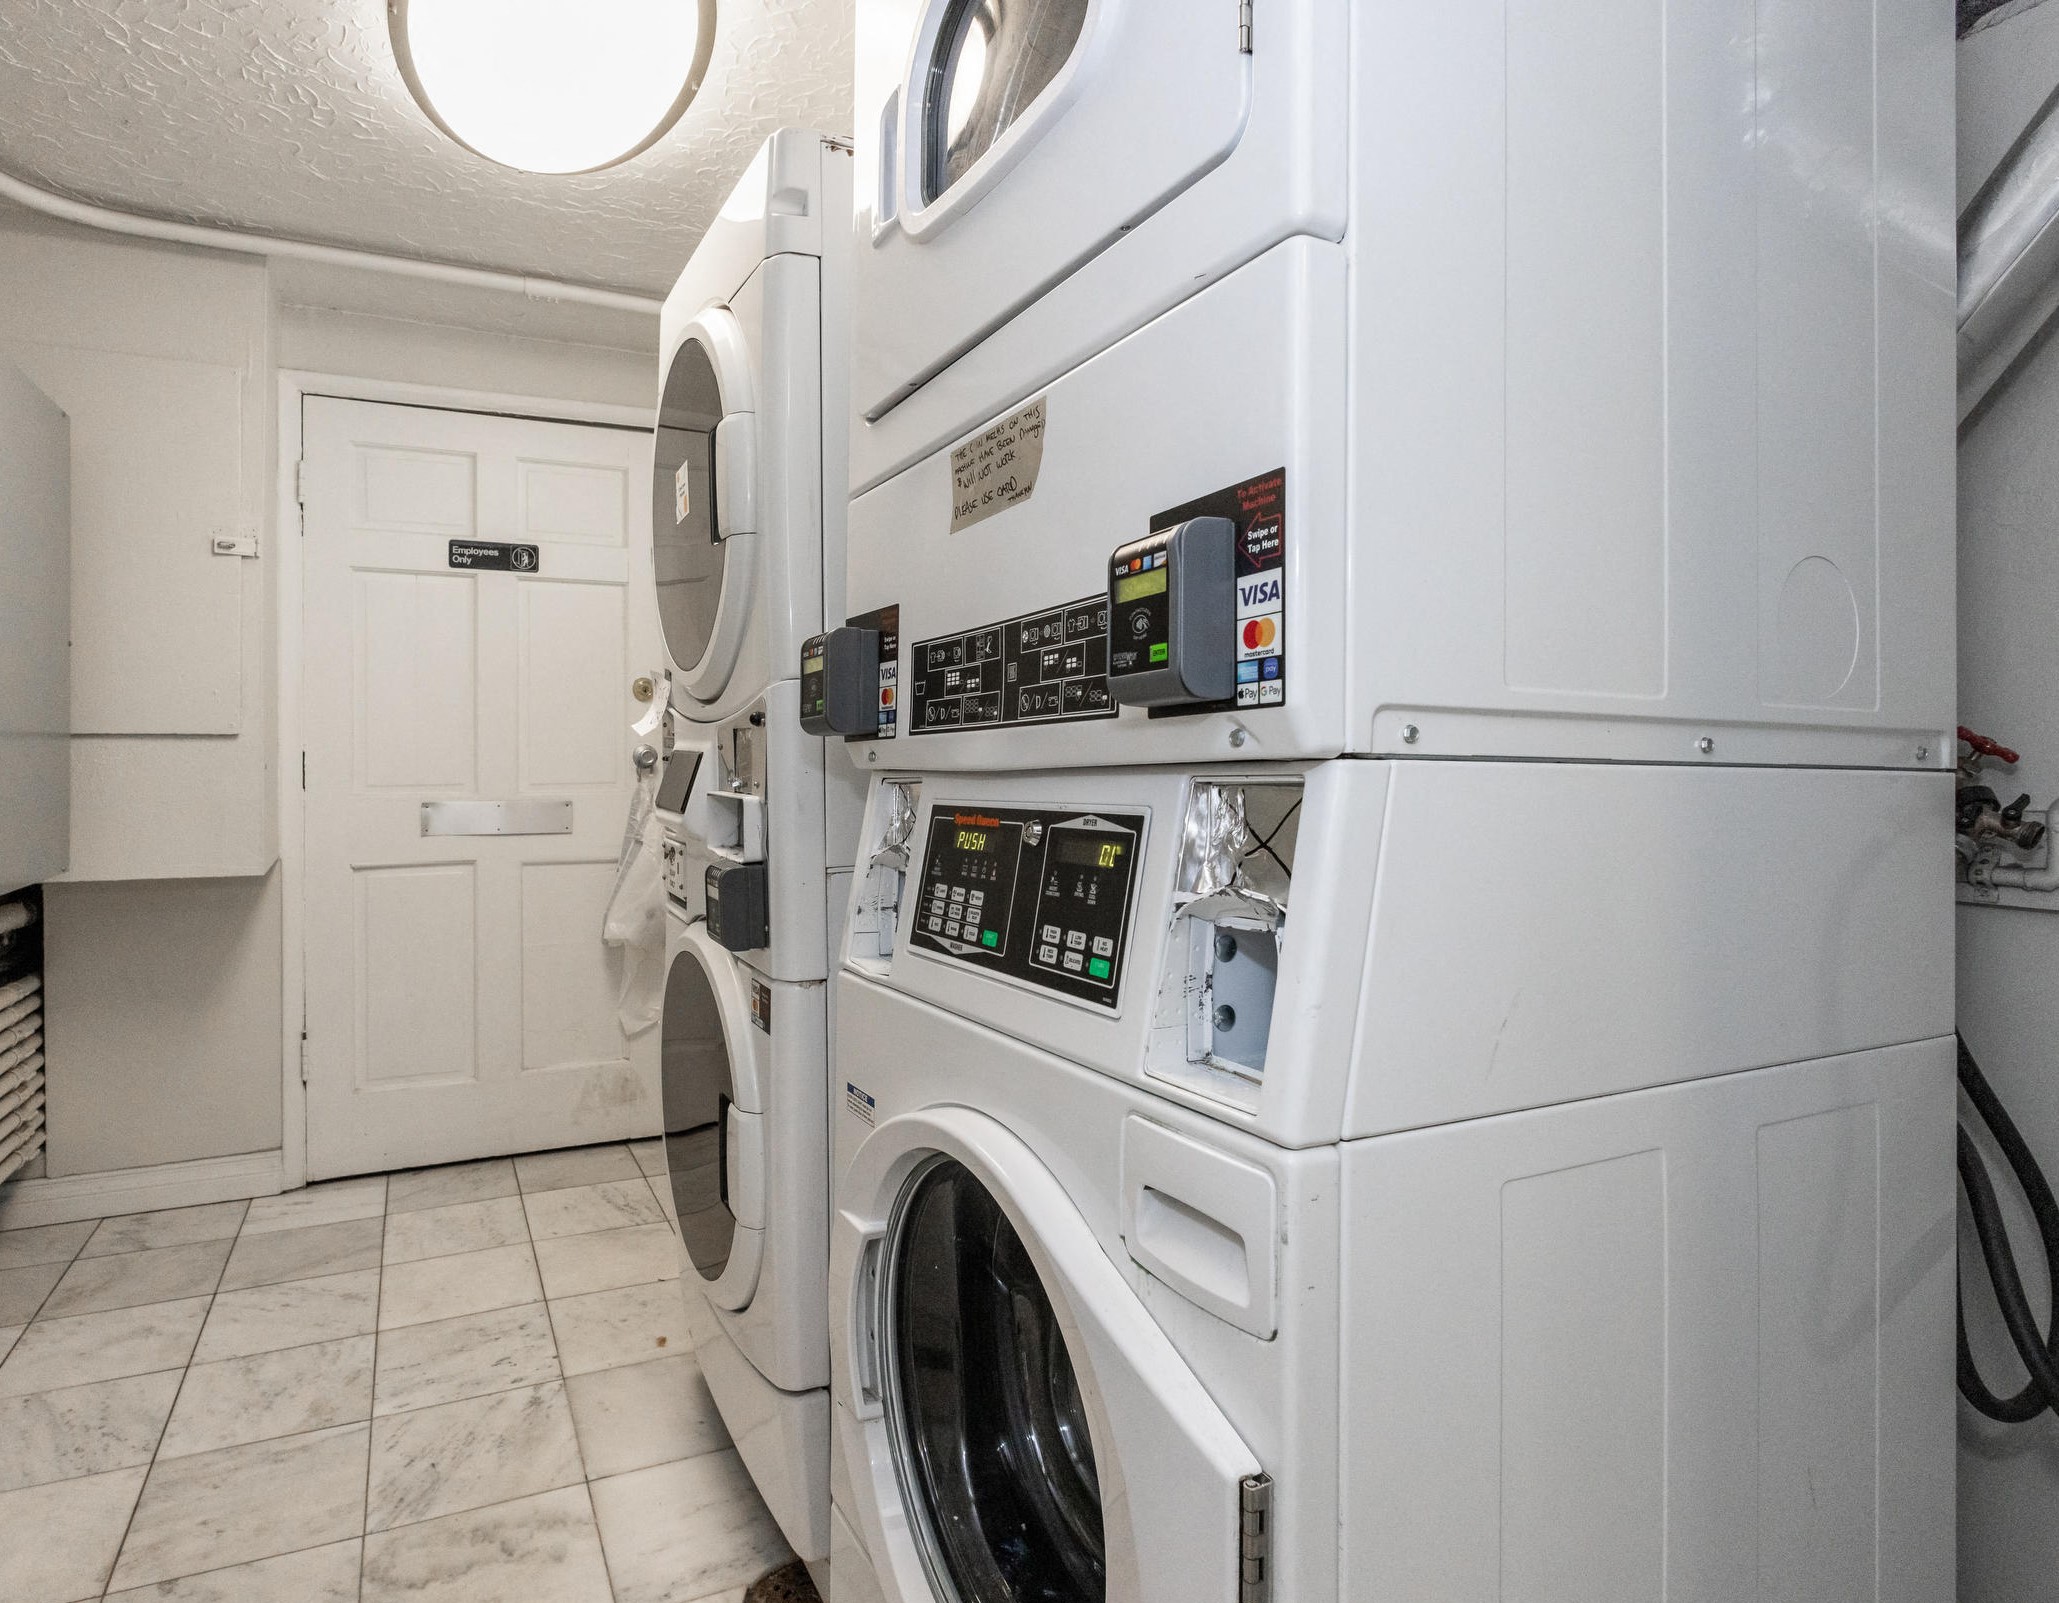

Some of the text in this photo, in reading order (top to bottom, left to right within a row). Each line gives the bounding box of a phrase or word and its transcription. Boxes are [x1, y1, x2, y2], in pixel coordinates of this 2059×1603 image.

[1009, 418, 1019, 430] ON
[1023, 405, 1041, 421] THIS
[997, 435, 1016, 451] BEEN
[978, 463, 993, 481] NOT
[996, 449, 1016, 470] WORK
[1237, 479, 1281, 498] To Activate
[954, 475, 1018, 520] PLEASE USE CARD
[1243, 494, 1277, 511] Machine
[1247, 525, 1279, 541] Swipe or
[452, 545, 499, 557] Employees
[1247, 539, 1279, 554] Tap Here
[452, 555, 472, 565] Only
[1115, 565, 1129, 576] VISA
[1239, 580, 1280, 607] VISA
[1244, 648, 1275, 658] mastercard
[881, 667, 896, 680] VISA
[1245, 688, 1257, 700] Pay
[1269, 686, 1281, 697] Pay
[956, 831, 987, 851] PUSH
